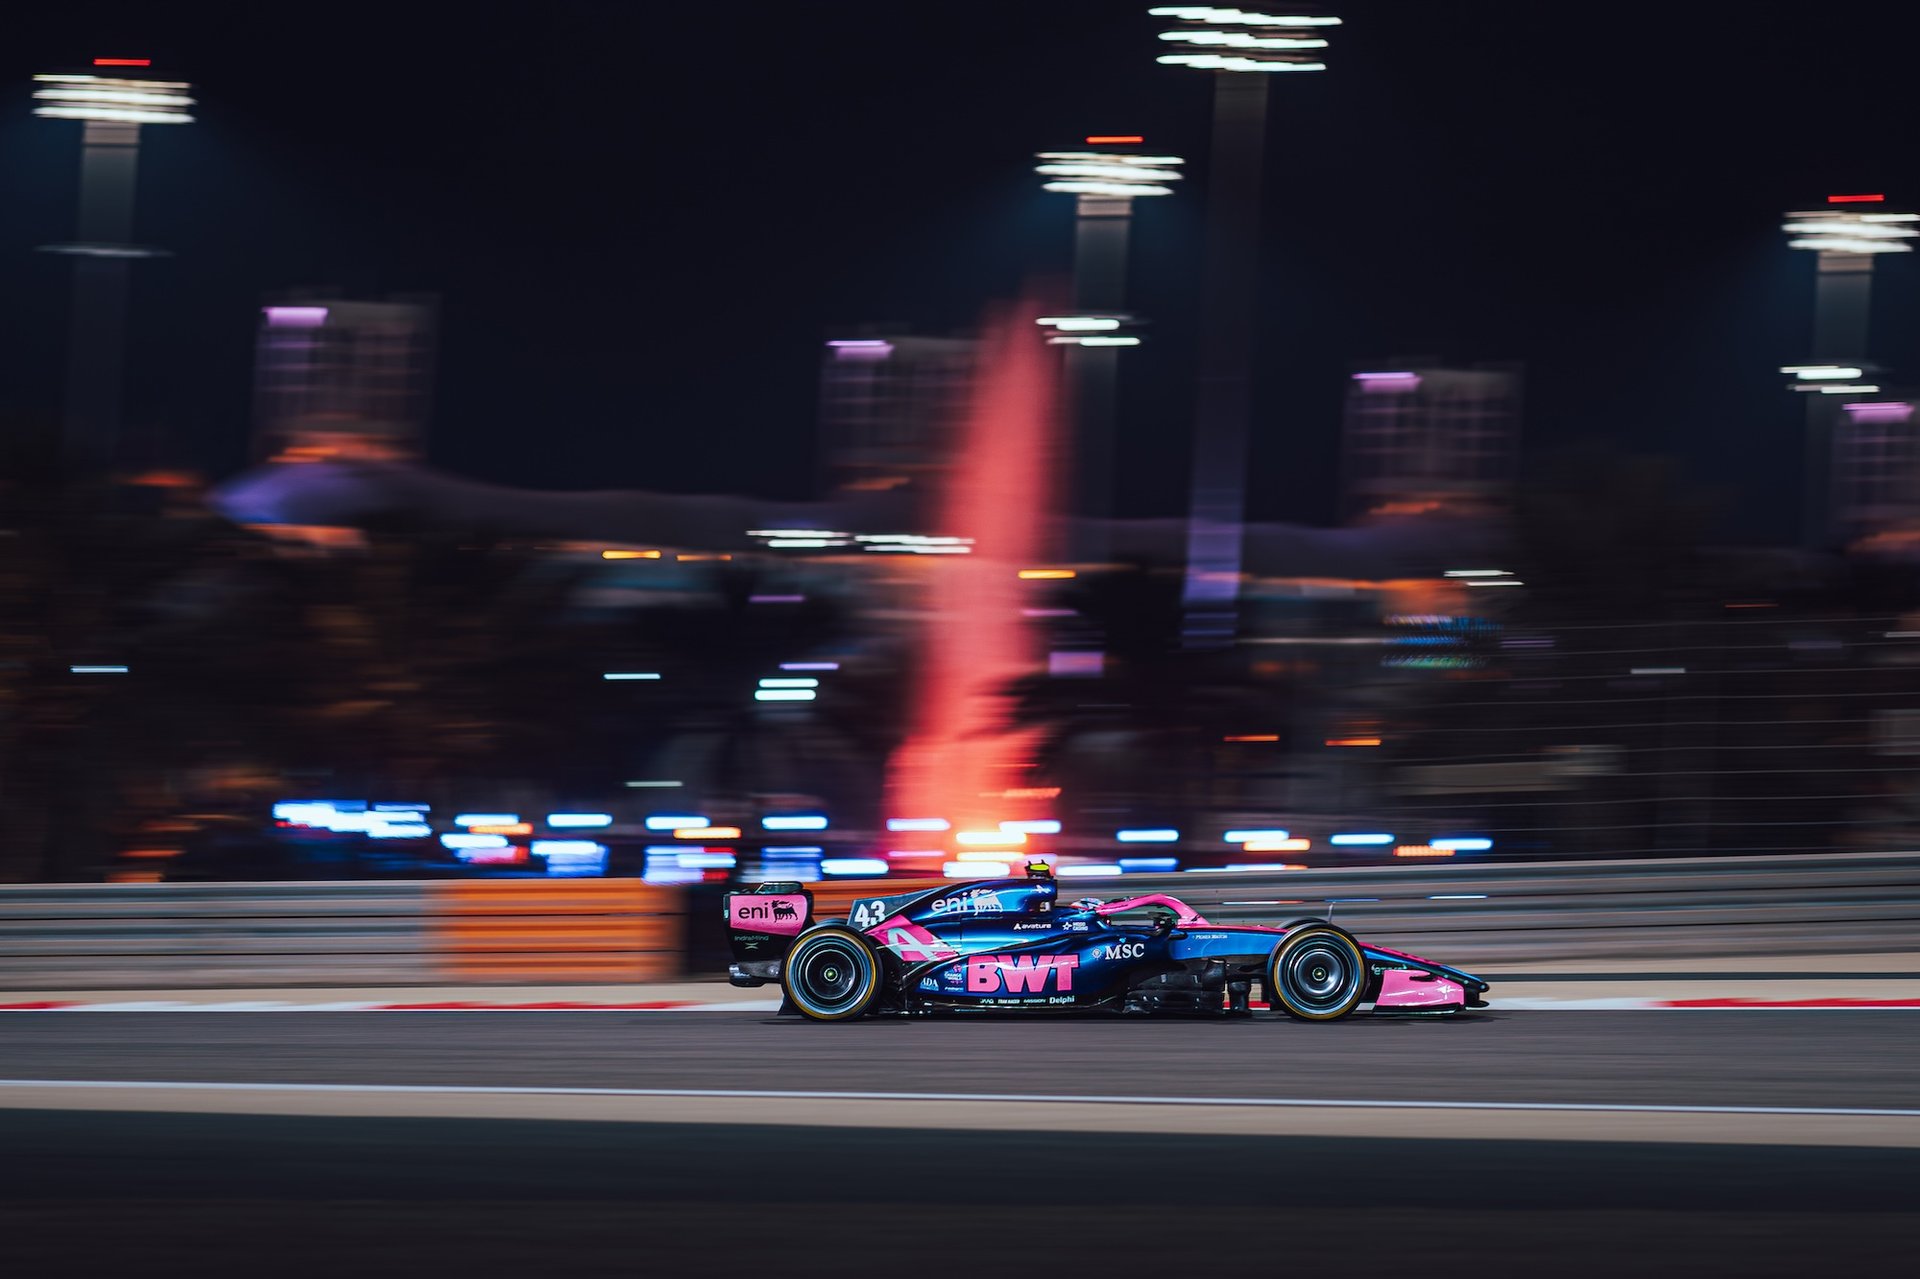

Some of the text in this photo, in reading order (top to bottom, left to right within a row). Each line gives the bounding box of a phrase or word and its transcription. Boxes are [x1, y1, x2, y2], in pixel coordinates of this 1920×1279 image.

[738, 902, 769, 919] eni
[931, 892, 968, 912] eni
[854, 900, 886, 928] 43
[1105, 943, 1145, 960] MSC
[920, 977, 939, 987] ADA
[967, 954, 1079, 993] BWT
[1049, 995, 1075, 1004] Delphi
